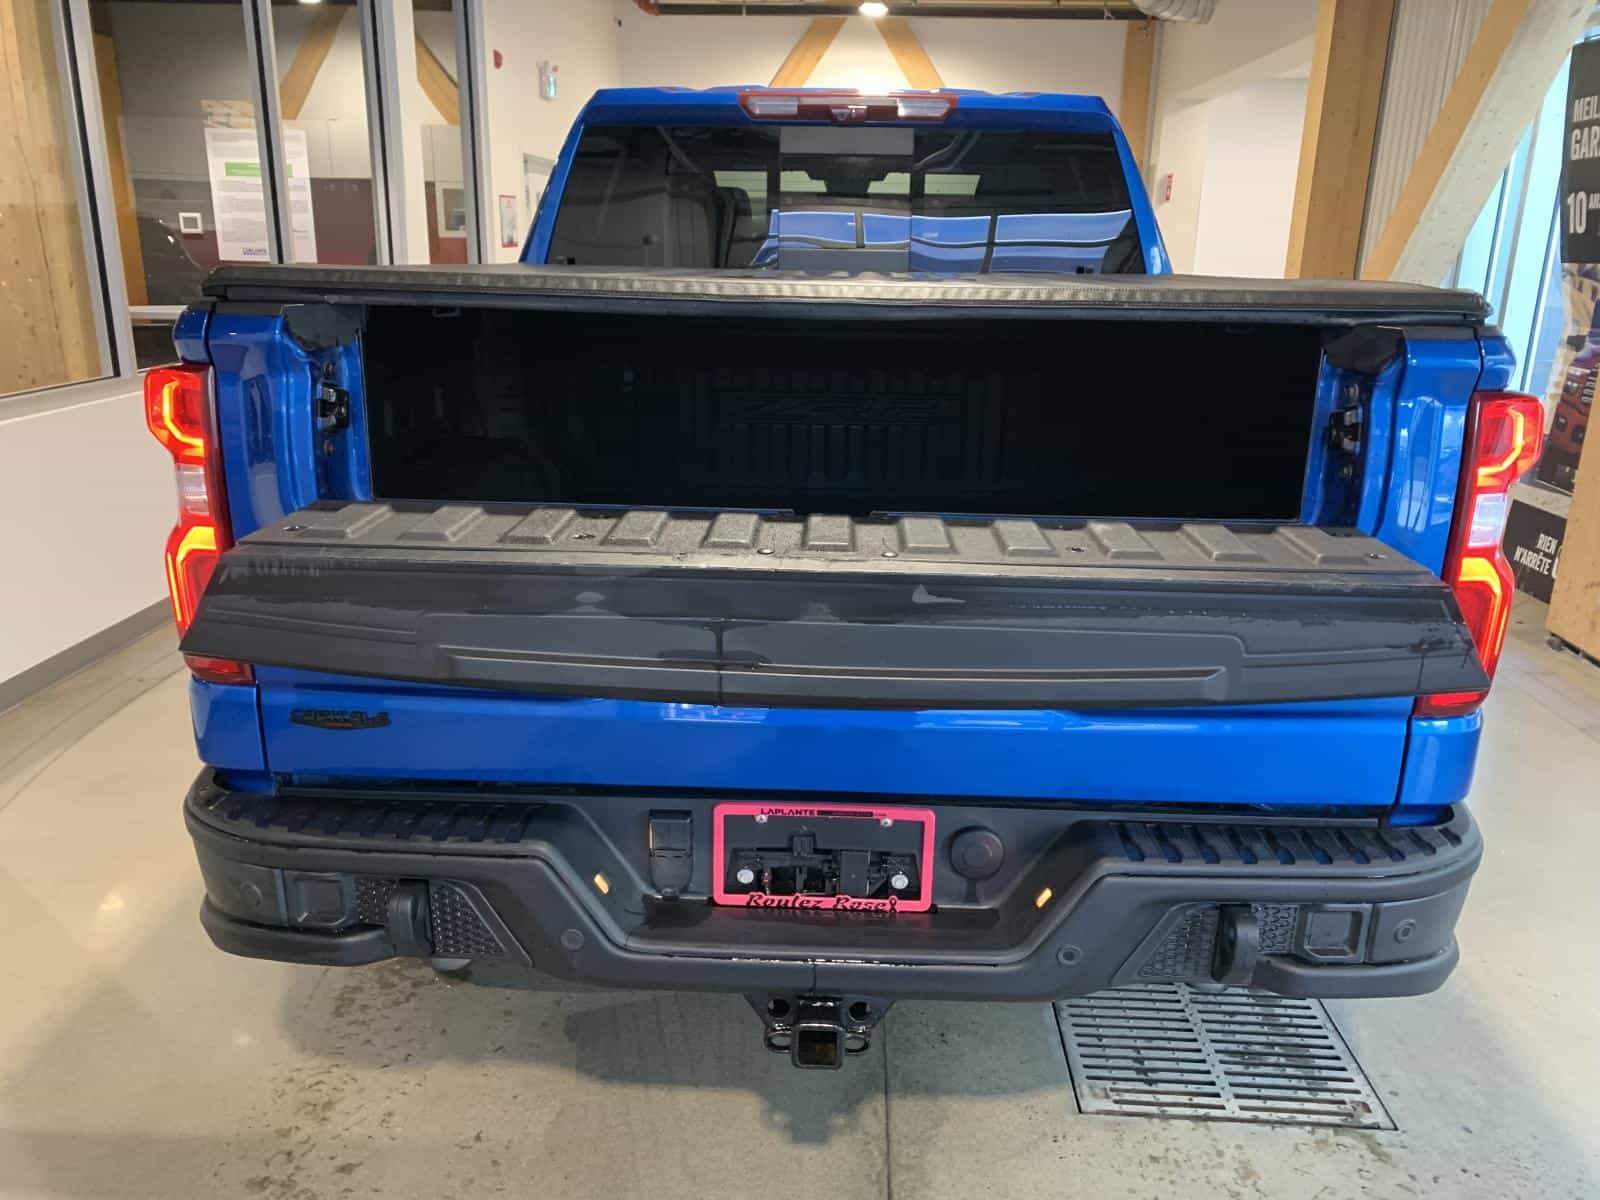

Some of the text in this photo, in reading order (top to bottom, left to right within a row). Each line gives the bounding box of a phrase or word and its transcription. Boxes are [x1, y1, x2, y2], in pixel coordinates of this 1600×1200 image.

[1567, 191, 1587, 234] 10
[1537, 533, 1558, 554] RIEN
[760, 808, 816, 816] LAPLANTE
[746, 893, 887, 912] Roulez Rose
